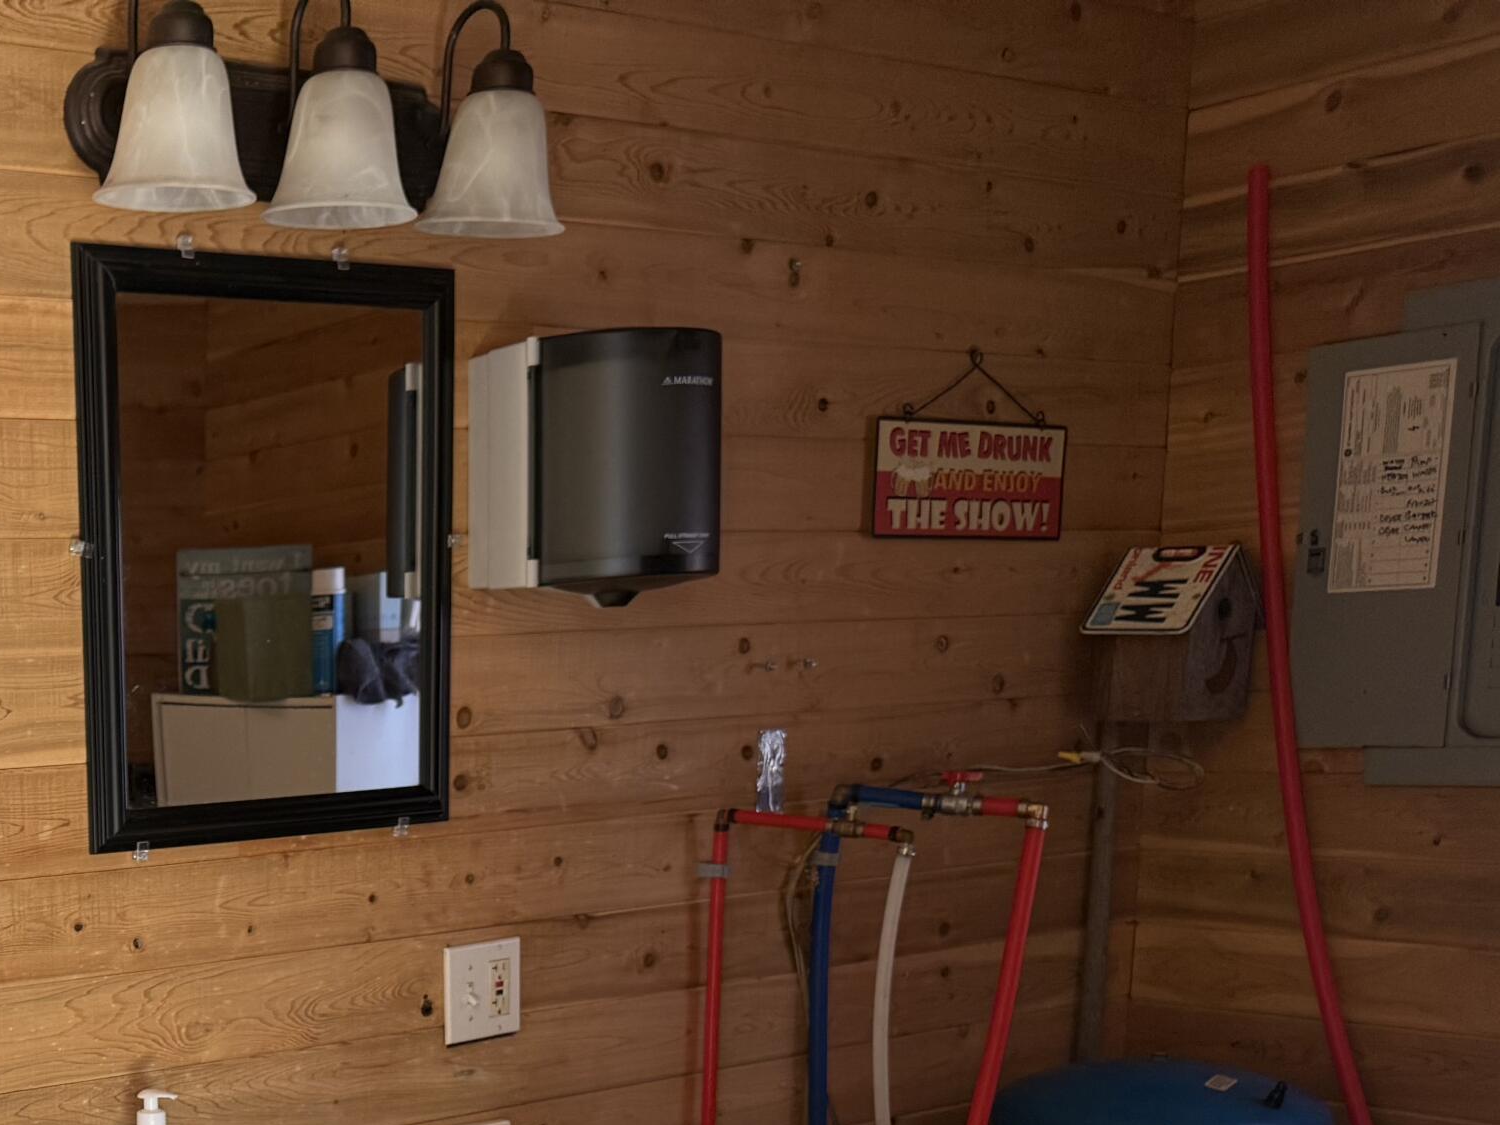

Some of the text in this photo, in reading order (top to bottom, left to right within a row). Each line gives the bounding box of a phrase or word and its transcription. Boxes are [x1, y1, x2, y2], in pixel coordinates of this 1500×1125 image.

[889, 427, 1053, 462] GET ME DRUNK
[935, 469, 1043, 493] AND ENJOY
[886, 497, 1050, 532] THE SHOW!
